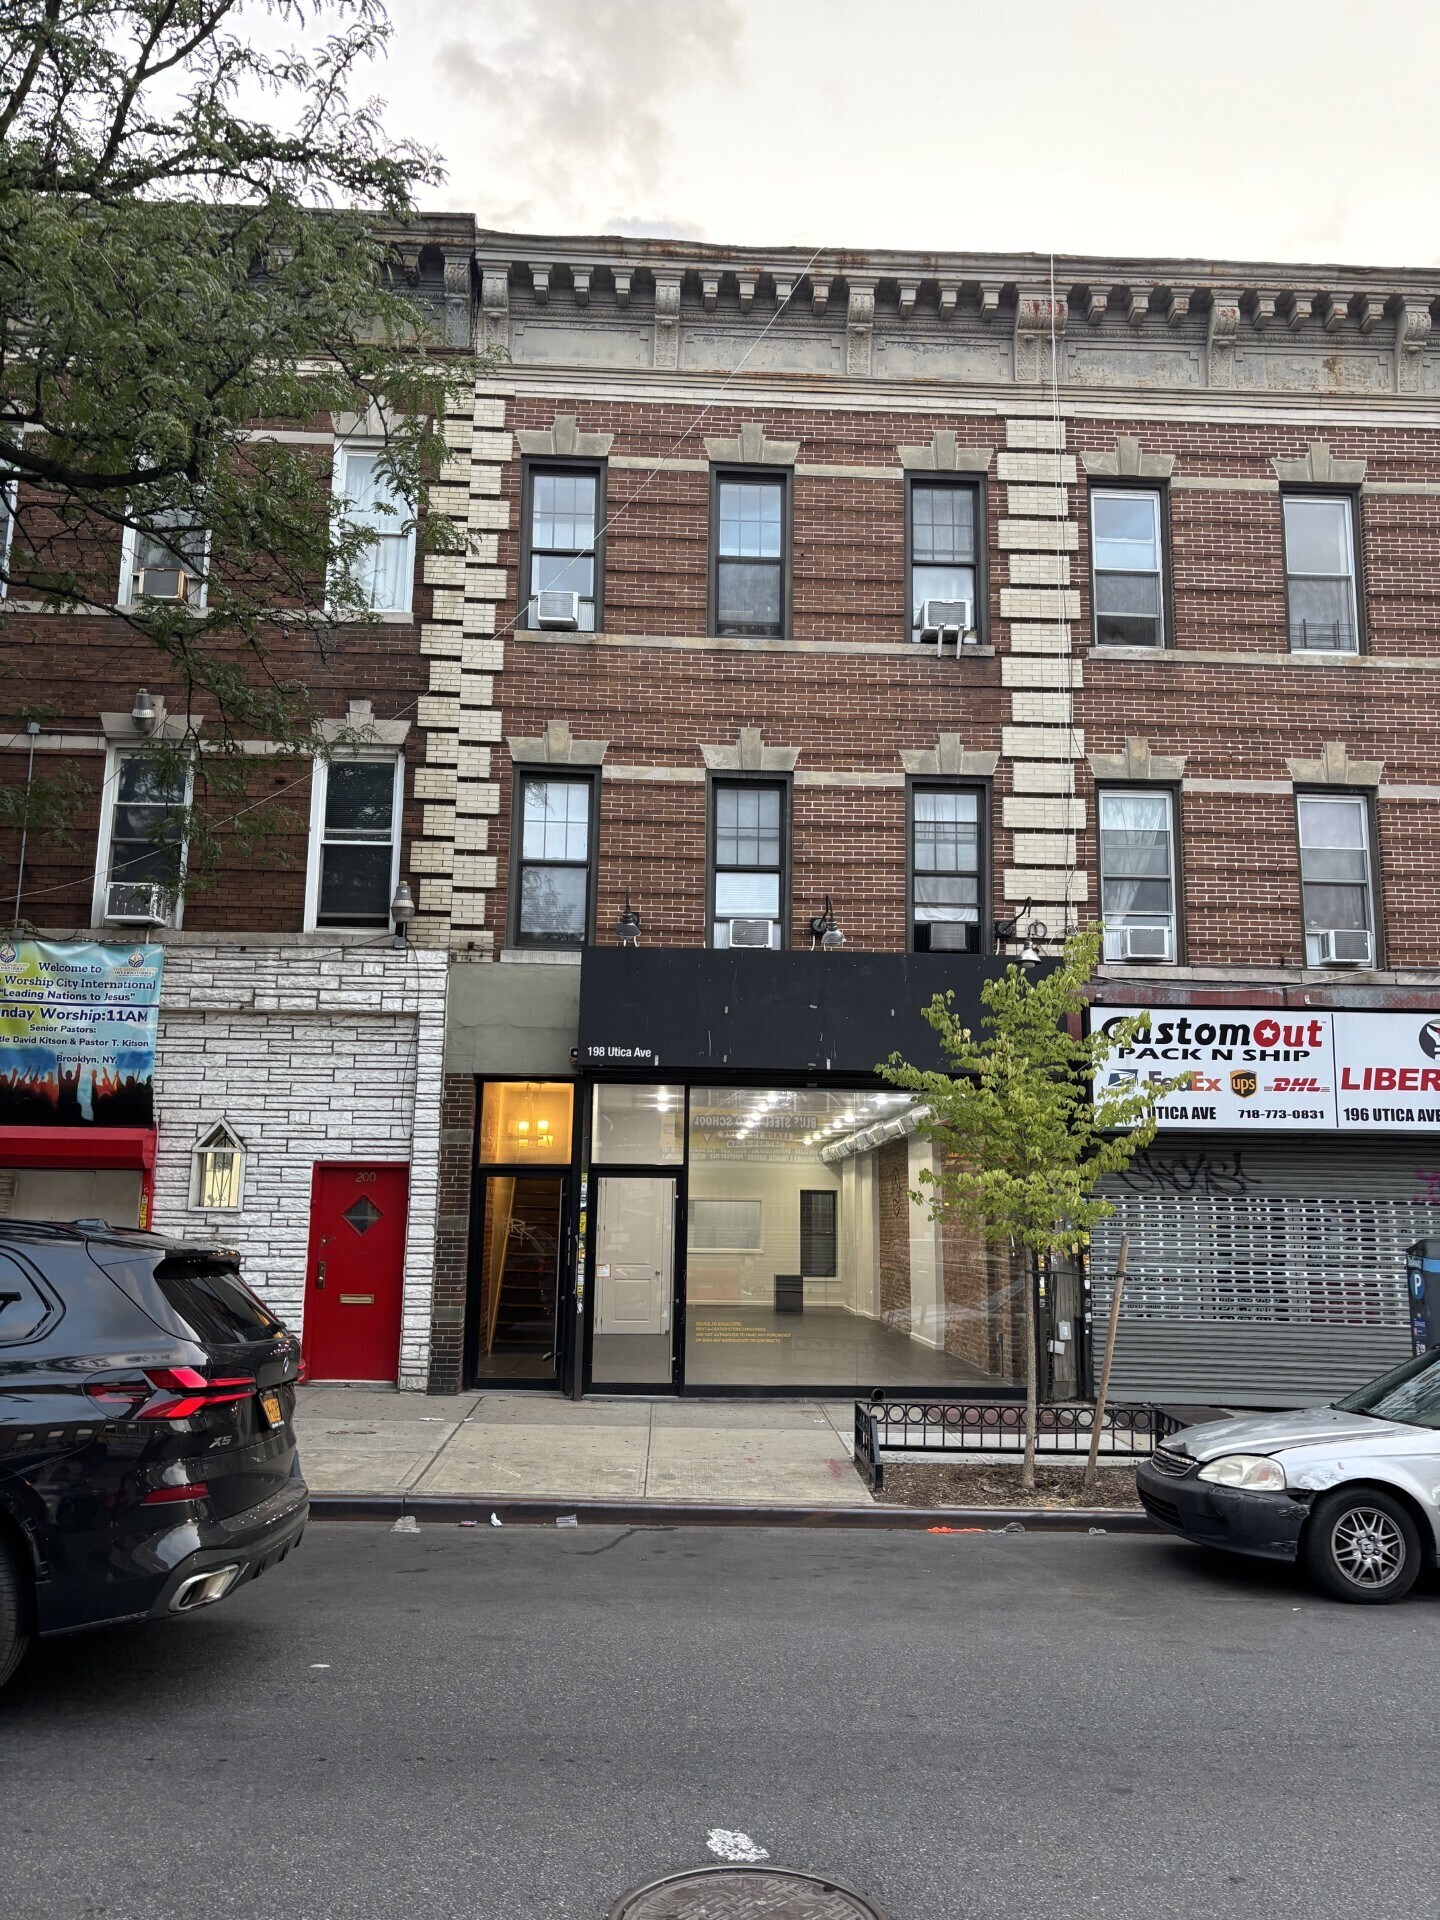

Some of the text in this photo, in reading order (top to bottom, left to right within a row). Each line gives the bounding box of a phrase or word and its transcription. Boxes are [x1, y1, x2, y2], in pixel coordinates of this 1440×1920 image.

[38, 961, 102, 974] Welcome to
[5, 975, 156, 990] Worship City International
[47, 990, 87, 1001] Nations
[90, 993, 101, 1001] to
[40, 1007, 149, 1024] Worship:11AM
[30, 1024, 97, 1034] Senior Pastors:
[13, 1036, 37, 1044] David
[39, 1036, 67, 1045] Kitson
[79, 1038, 109, 1047] Pastor
[111, 1039, 120, 1047] T.
[587, 1046, 652, 1058] 198 Utica Ave
[1118, 1047, 1310, 1062] PACK N SHIP
[56, 1054, 100, 1064] Brooklyn,
[1232, 1077, 1256, 1095] ups
[1272, 1077, 1321, 1092] DHL
[1191, 1106, 1217, 1120] AVE
[1238, 1109, 1325, 1120] 718-773-0831
[1343, 1108, 1370, 1122] 196
[1372, 1108, 1415, 1122] UTICA
[355, 1171, 377, 1183] 200
[209, 1435, 232, 1448] X5
